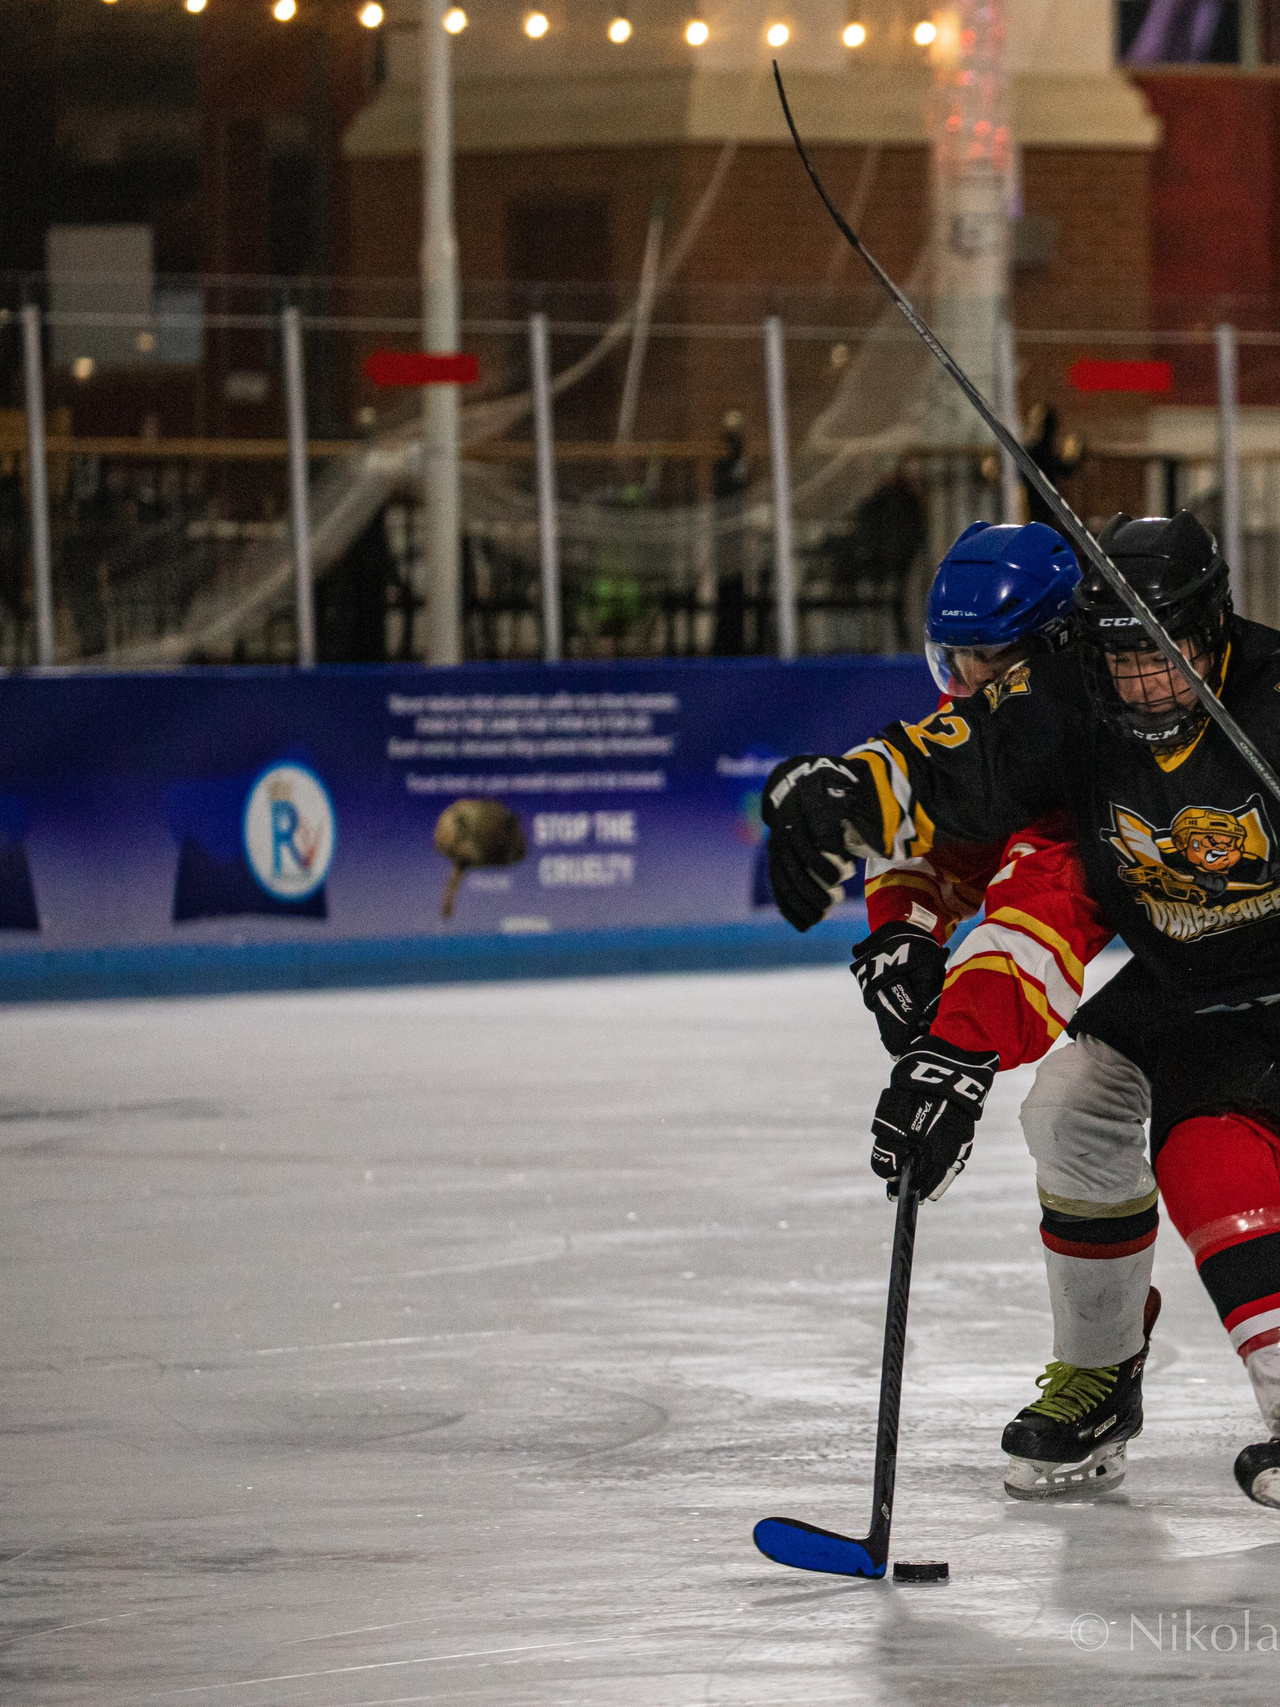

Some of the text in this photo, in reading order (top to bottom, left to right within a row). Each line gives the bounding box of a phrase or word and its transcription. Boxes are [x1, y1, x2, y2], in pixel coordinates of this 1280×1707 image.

[1099, 616, 1142, 627] CCM
[1133, 724, 1180, 741] CCM
[856, 942, 910, 992] CM
[891, 986, 912, 1012] TACKS
[910, 1061, 988, 1107] CC
[915, 1100, 933, 1132] TACKS
